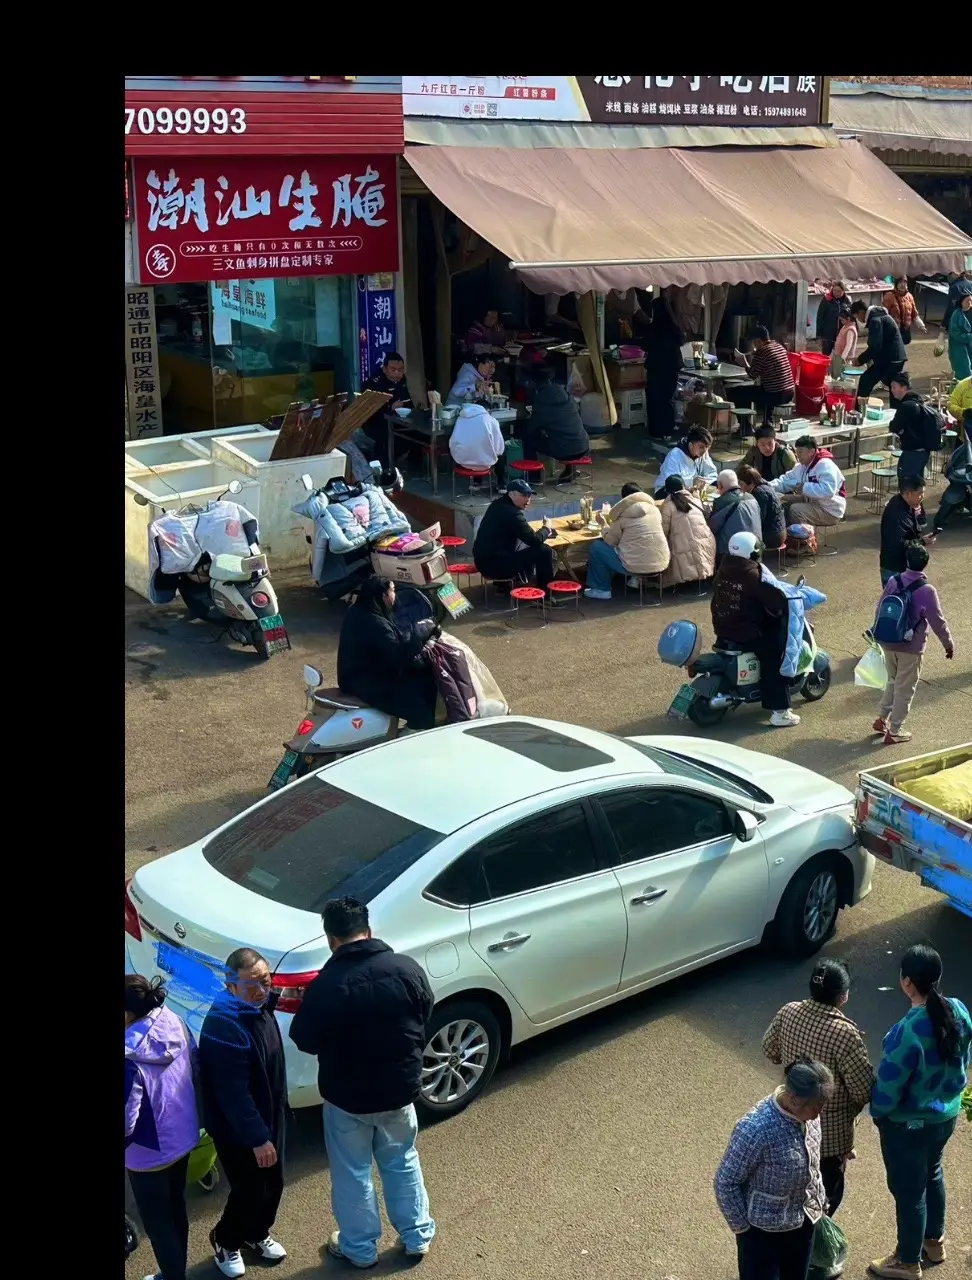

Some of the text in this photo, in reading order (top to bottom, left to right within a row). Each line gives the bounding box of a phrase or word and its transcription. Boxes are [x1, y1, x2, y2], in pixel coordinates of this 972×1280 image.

[605, 101, 621, 113] 米线
[623, 102, 639, 114] 面条
[683, 103, 698, 115] 豆浆
[146, 164, 388, 233] 潮汕生腌
[213, 254, 334, 270] 三文鱼刺身拼盘定制专家
[127, 291, 158, 437] 昭通市昭阳区海皇水产
